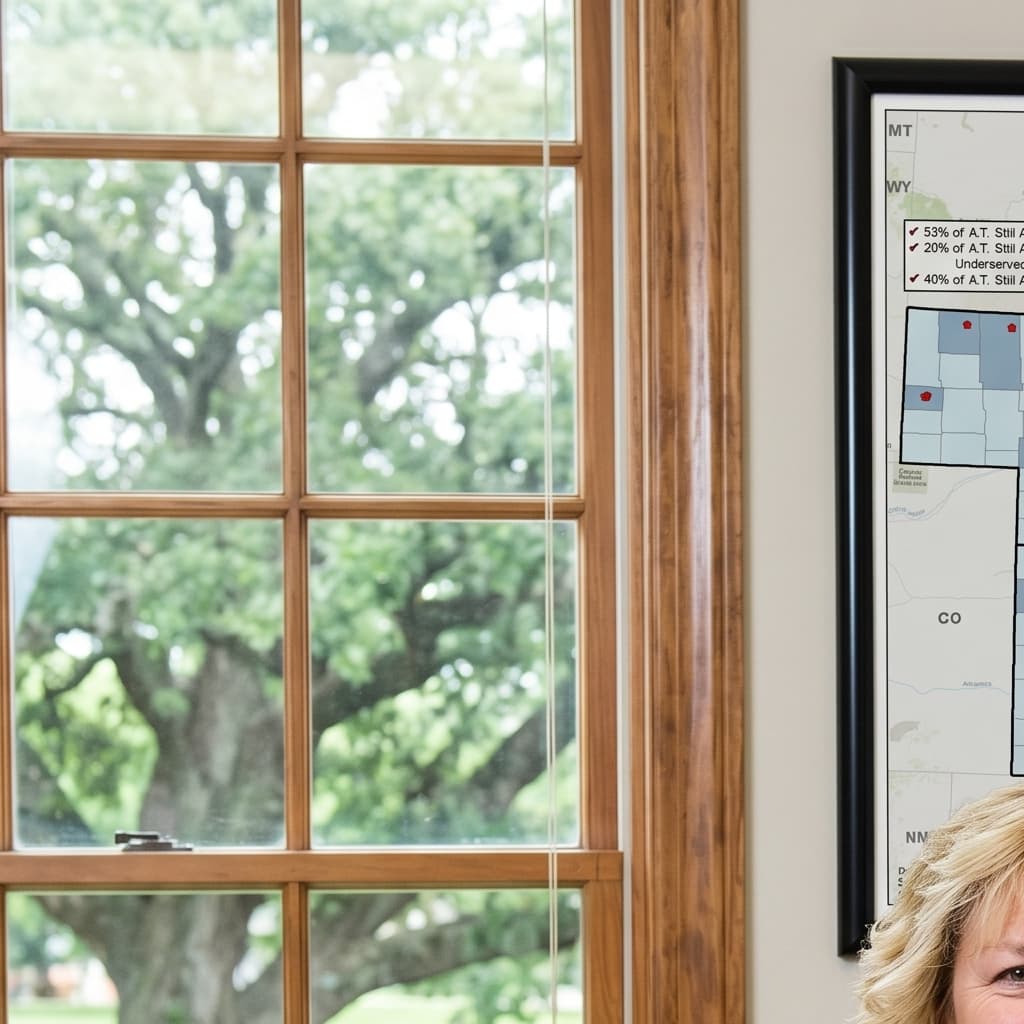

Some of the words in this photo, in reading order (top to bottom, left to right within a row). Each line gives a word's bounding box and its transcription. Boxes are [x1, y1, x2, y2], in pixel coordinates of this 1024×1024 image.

[888, 124, 913, 137] MT
[886, 181, 912, 193] WY
[924, 227, 949, 238] 53%
[953, 227, 964, 238] of
[969, 228, 990, 238] A.T.
[924, 243, 949, 253] 20%
[953, 243, 964, 253] of
[969, 243, 990, 254] A.T.
[924, 274, 949, 285] 40%
[953, 274, 964, 285] of
[969, 275, 990, 285] A.T.
[938, 612, 962, 625] CO
